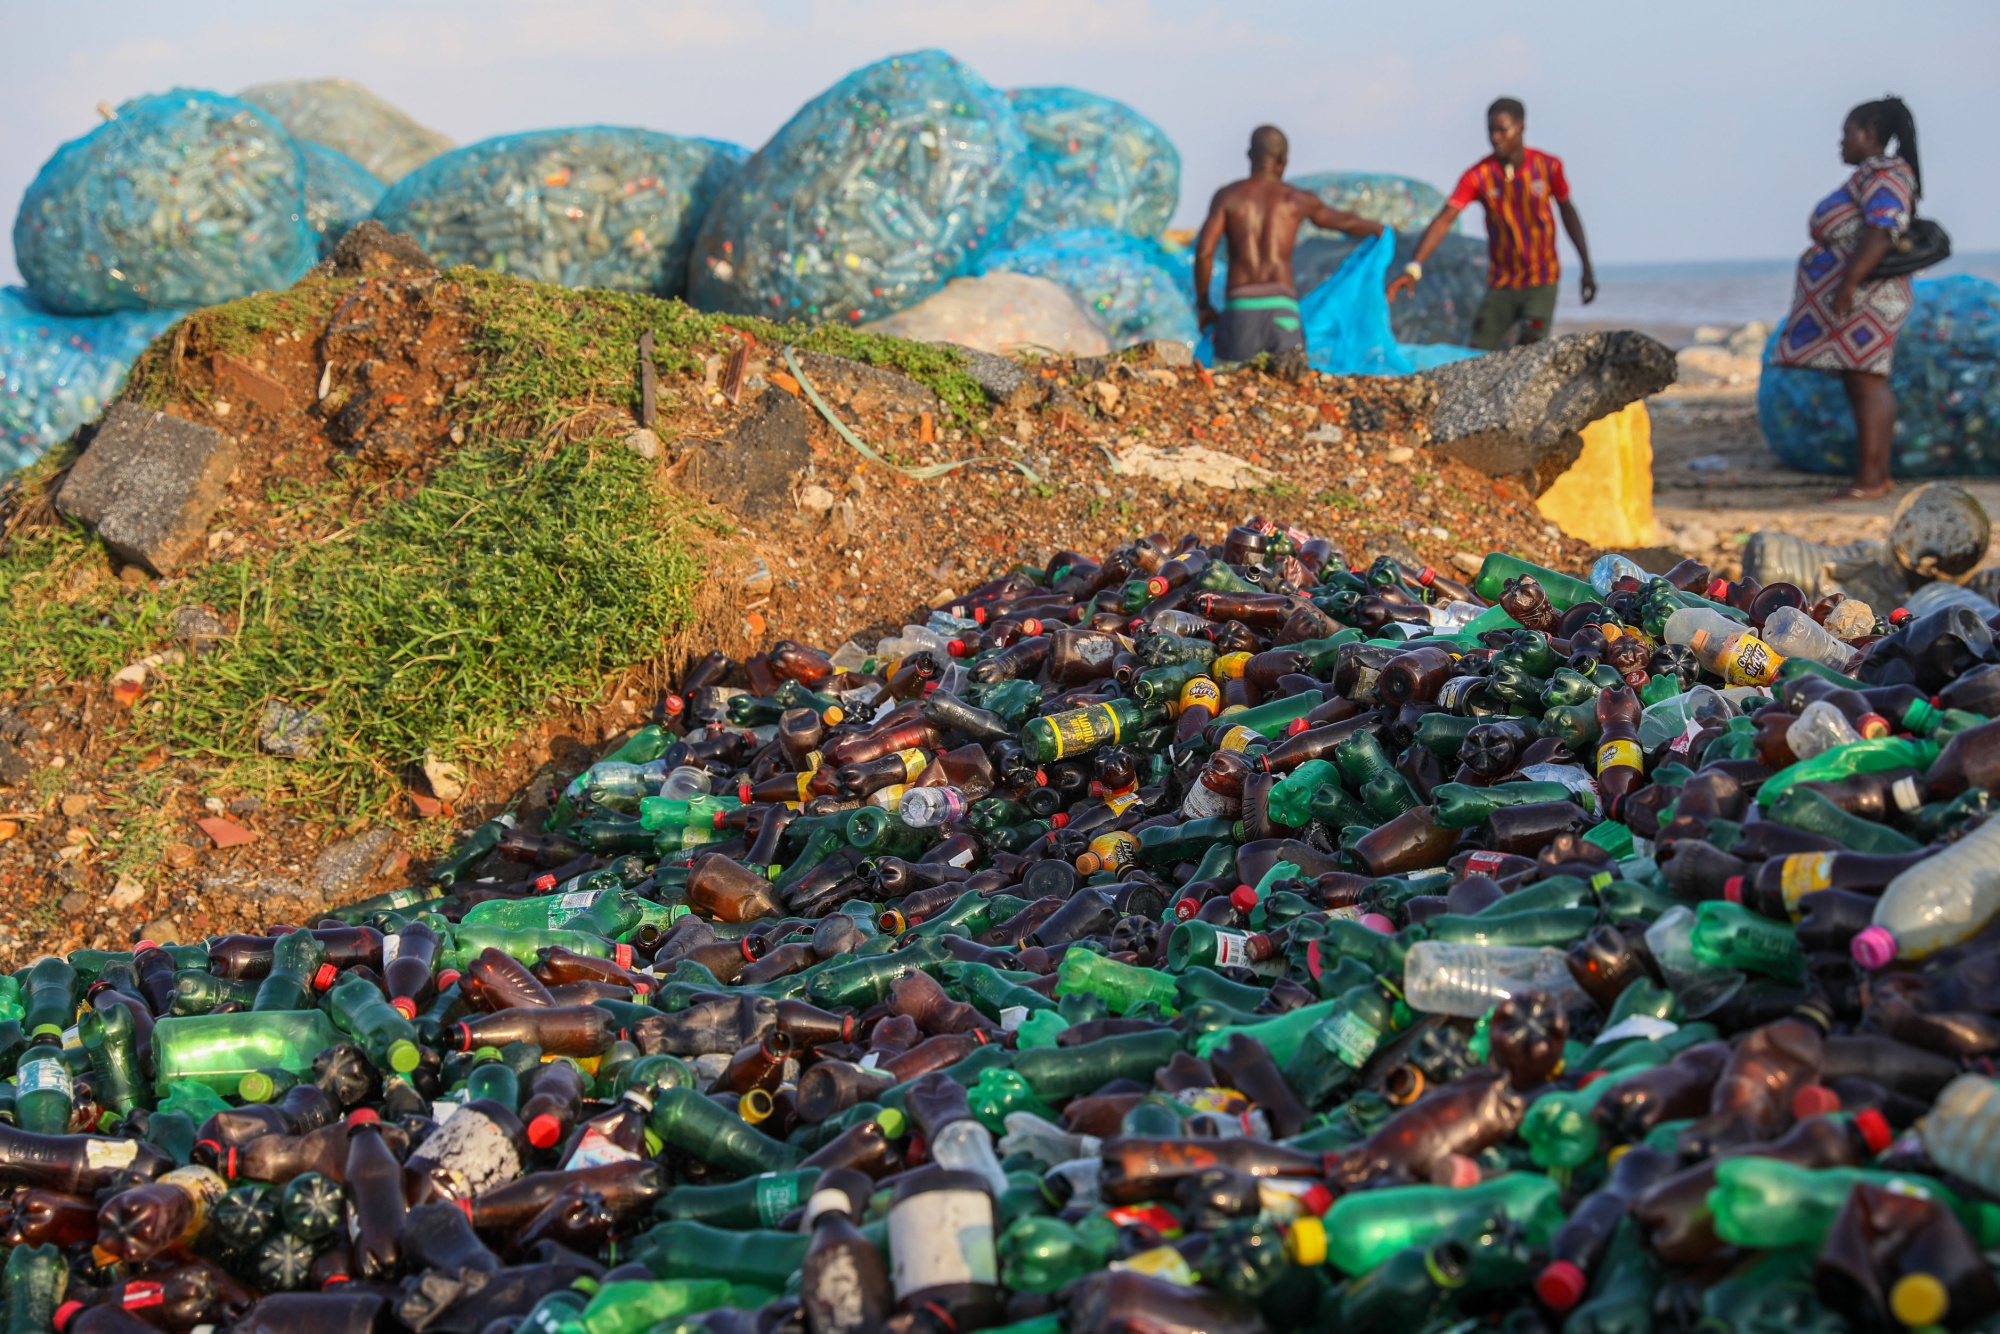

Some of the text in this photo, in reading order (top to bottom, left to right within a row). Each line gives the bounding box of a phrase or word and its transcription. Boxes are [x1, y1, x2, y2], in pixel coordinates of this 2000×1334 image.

[1738, 644, 1752, 667] Choco
[1745, 643, 1767, 677] MALT
[1077, 713, 1095, 743] ALOMO
